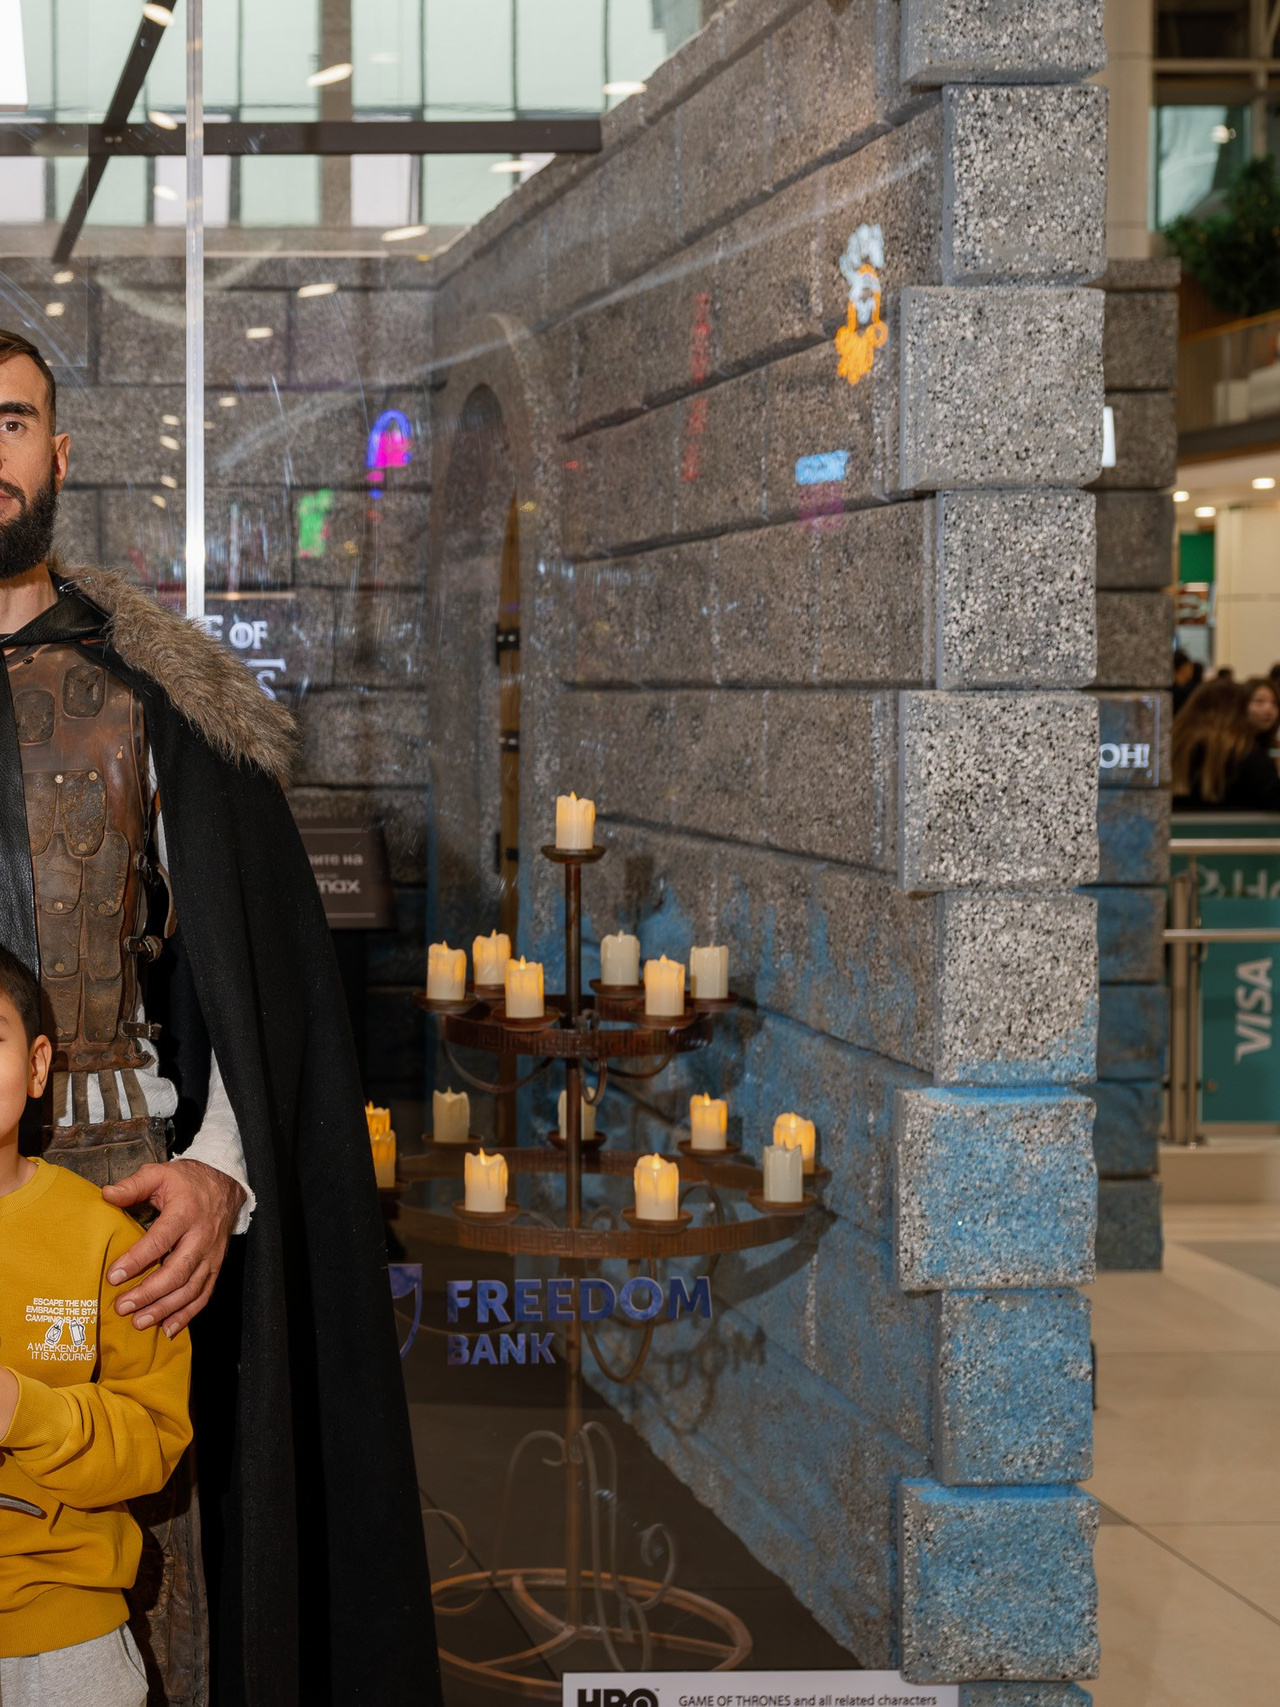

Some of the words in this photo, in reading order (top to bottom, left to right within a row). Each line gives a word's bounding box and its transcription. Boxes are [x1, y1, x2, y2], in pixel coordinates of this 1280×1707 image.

[1235, 957, 1273, 1064] VISA
[33, 1298, 64, 1306] ESCAPE
[65, 1299, 79, 1307] THE
[446, 1276, 712, 1324] FREEDOM
[25, 1305, 64, 1315] EMBRACE
[65, 1307, 79, 1315] THE
[27, 1342, 34, 1351] A
[35, 1344, 79, 1353] WEEKEND
[446, 1332, 556, 1366] BANK
[31, 1351, 39, 1359] IT
[40, 1352, 49, 1360] IS
[678, 1695, 714, 1707] GAME
[717, 1695, 733, 1707] OF
[735, 1695, 791, 1707] THRONES
[793, 1694, 816, 1707] and
[819, 1694, 832, 1706] all
[835, 1694, 875, 1706] related
[878, 1694, 938, 1706] characters
